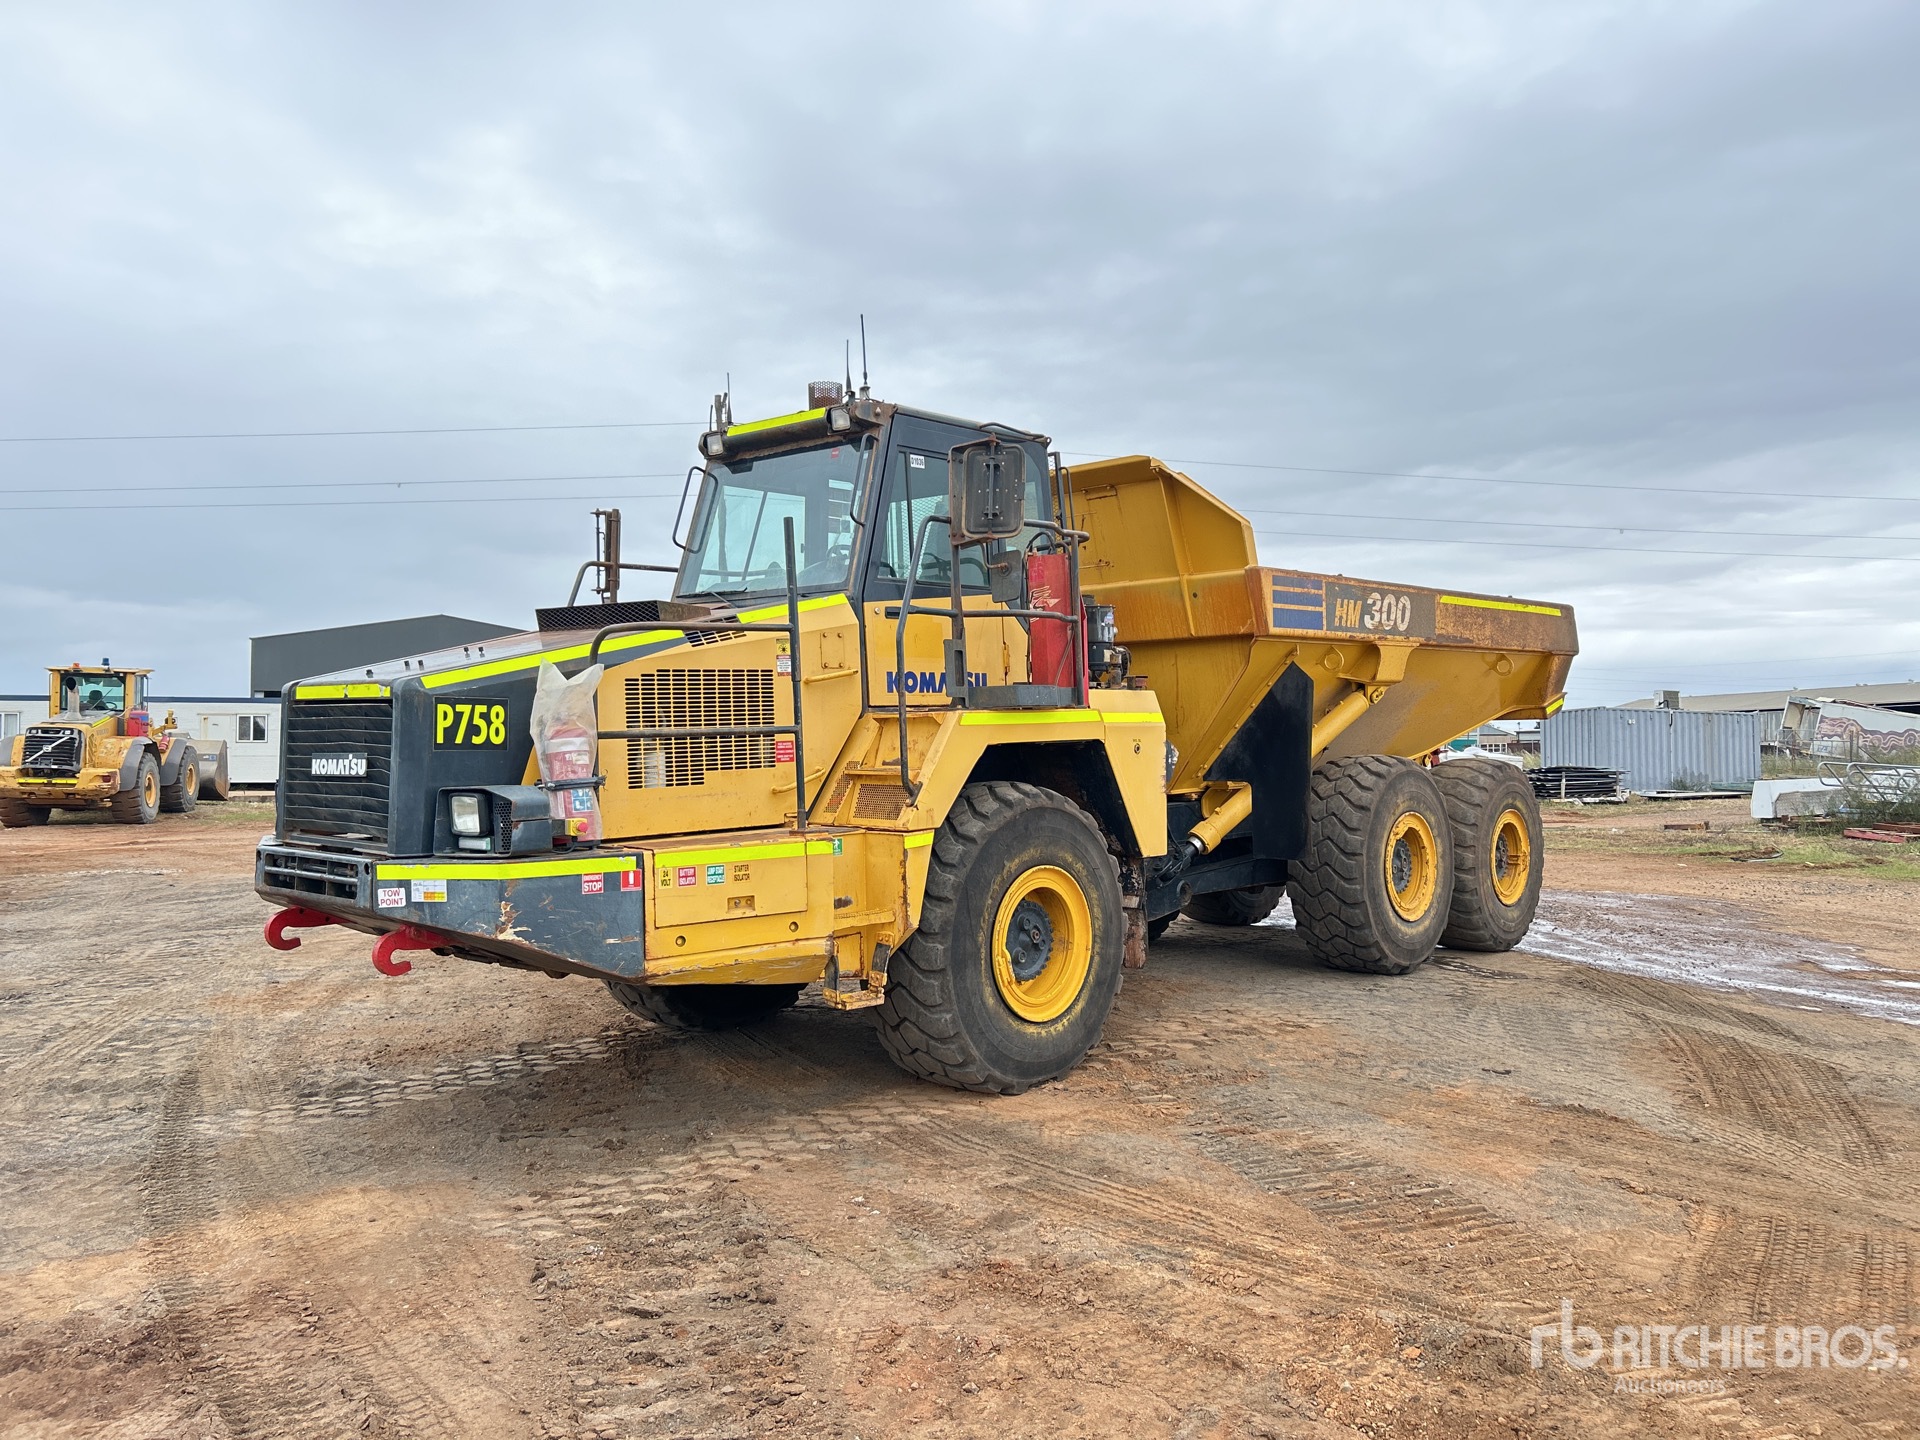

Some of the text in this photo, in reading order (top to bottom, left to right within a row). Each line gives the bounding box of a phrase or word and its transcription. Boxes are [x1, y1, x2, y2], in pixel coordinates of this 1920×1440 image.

[1334, 592, 1411, 631] HM 300
[436, 703, 506, 745] P758
[311, 754, 366, 776] KOMATSU
[679, 867, 695, 877] BATTERY
[734, 864, 750, 873] STARTER
[662, 870, 669, 878] 24
[733, 873, 750, 882] ISOLATOR
[660, 878, 671, 887] VOLT
[679, 876, 696, 886] ISOLATOR
[584, 881, 602, 892] STOP
[382, 889, 401, 898] TOW
[380, 898, 404, 906] POINT
